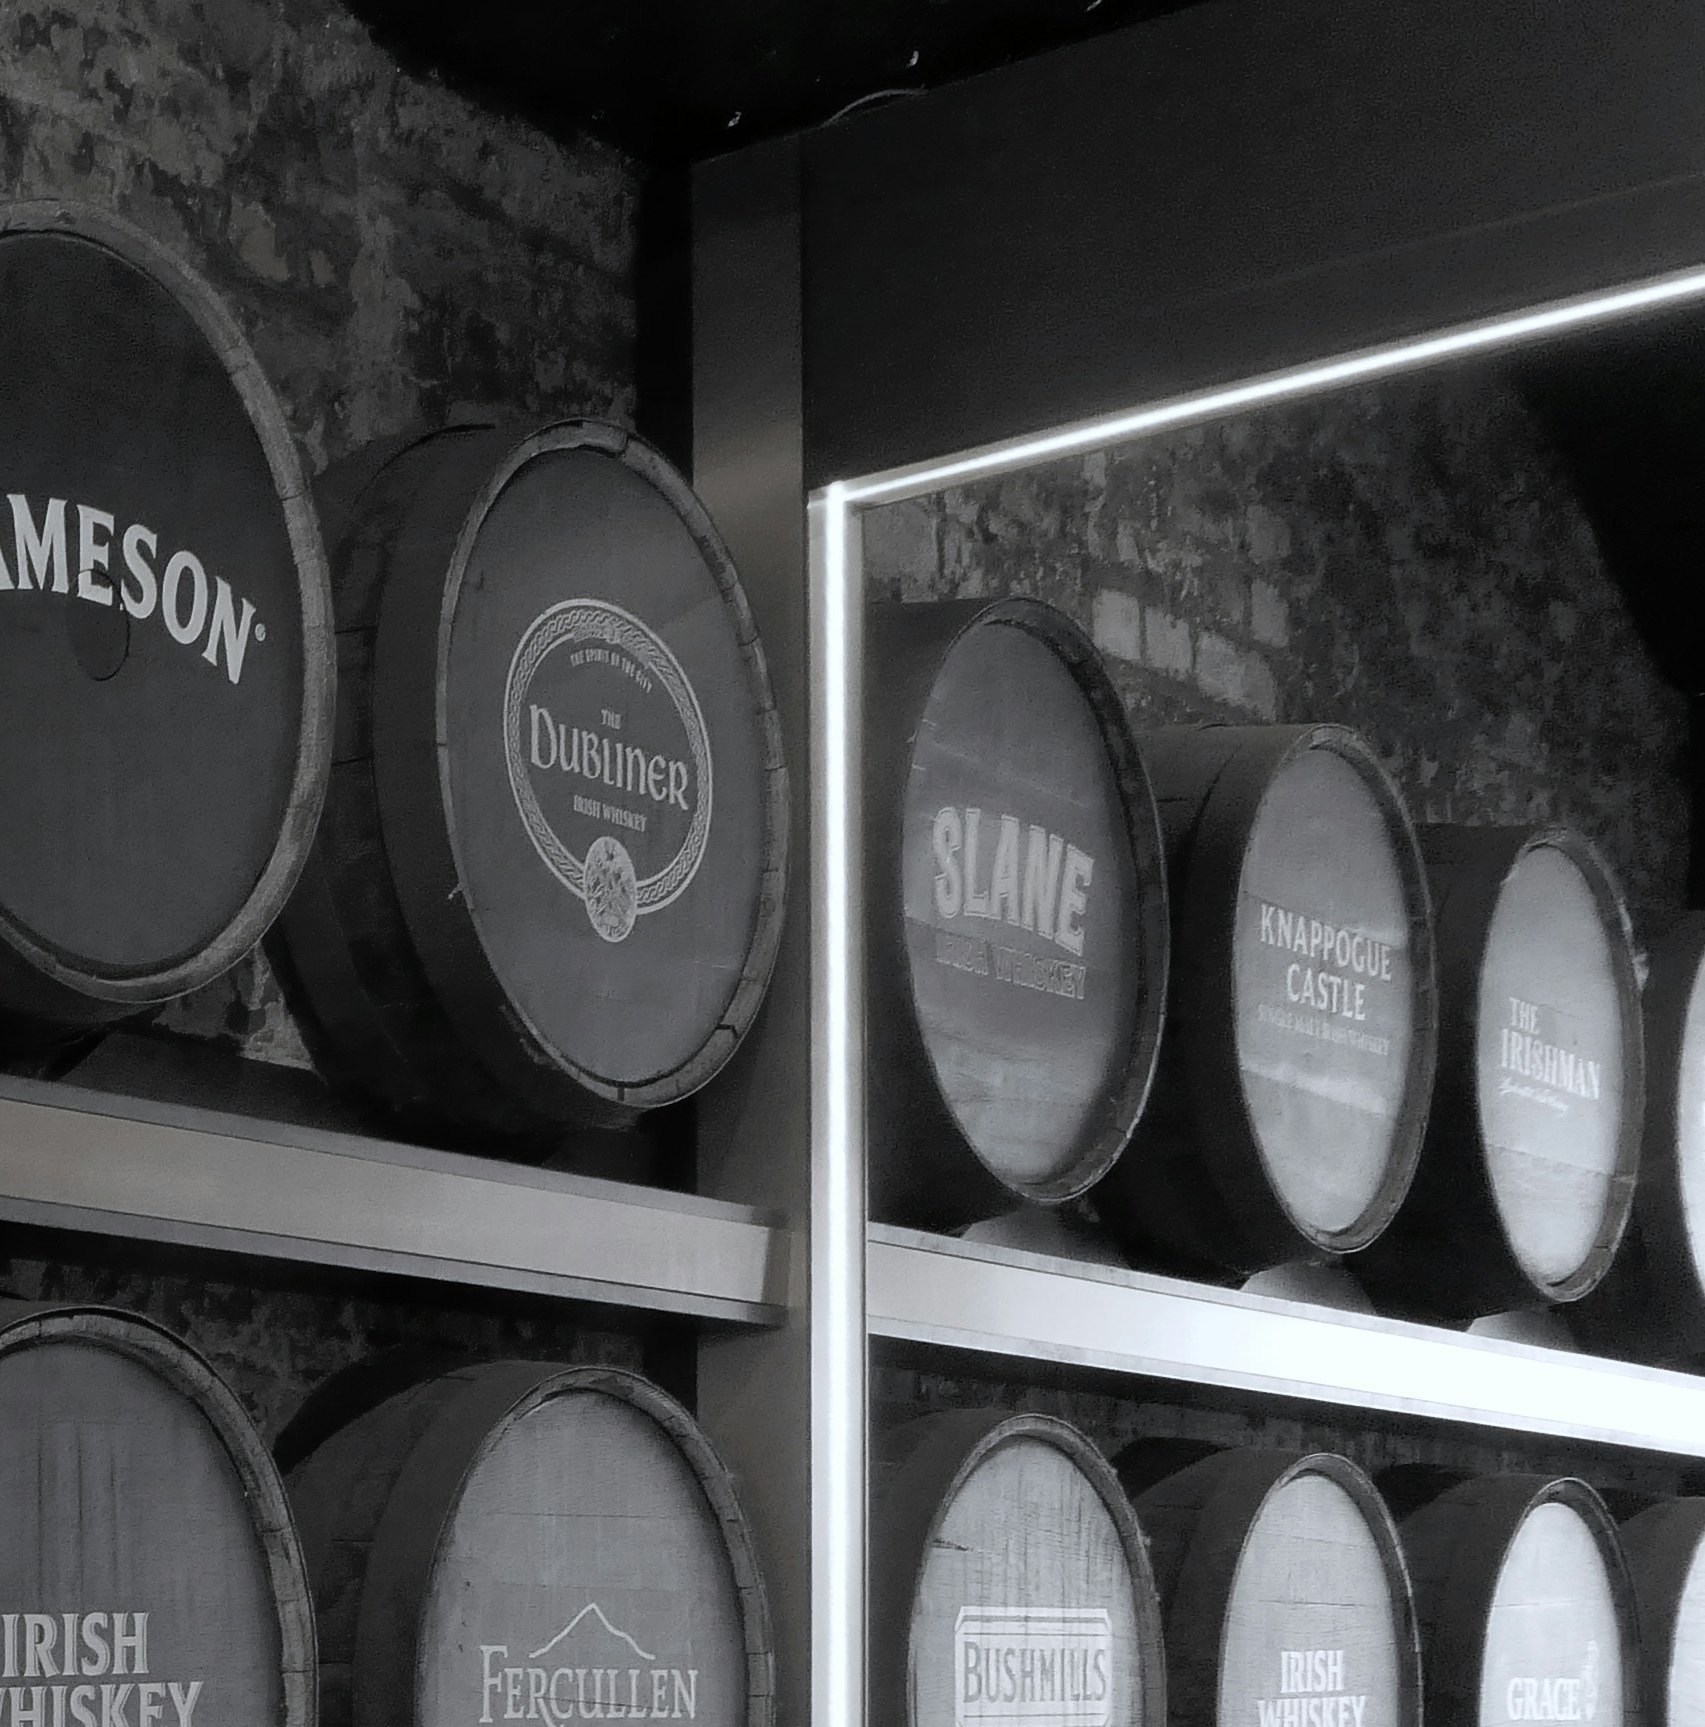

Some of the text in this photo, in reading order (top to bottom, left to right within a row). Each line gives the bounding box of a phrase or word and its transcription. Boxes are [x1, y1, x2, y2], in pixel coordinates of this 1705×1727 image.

[932, 807, 1094, 957] SLANE
[1260, 903, 1391, 981] KNAPPOGUE
[1286, 963, 1366, 1021] CASTLE
[1509, 996, 1540, 1035] THE
[2, 1612, 149, 1678] IRISH
[963, 1641, 1108, 1703] BUSHMILLS
[1280, 1649, 1344, 1693] IRISH
[1507, 1677, 1581, 1721] GRACE
